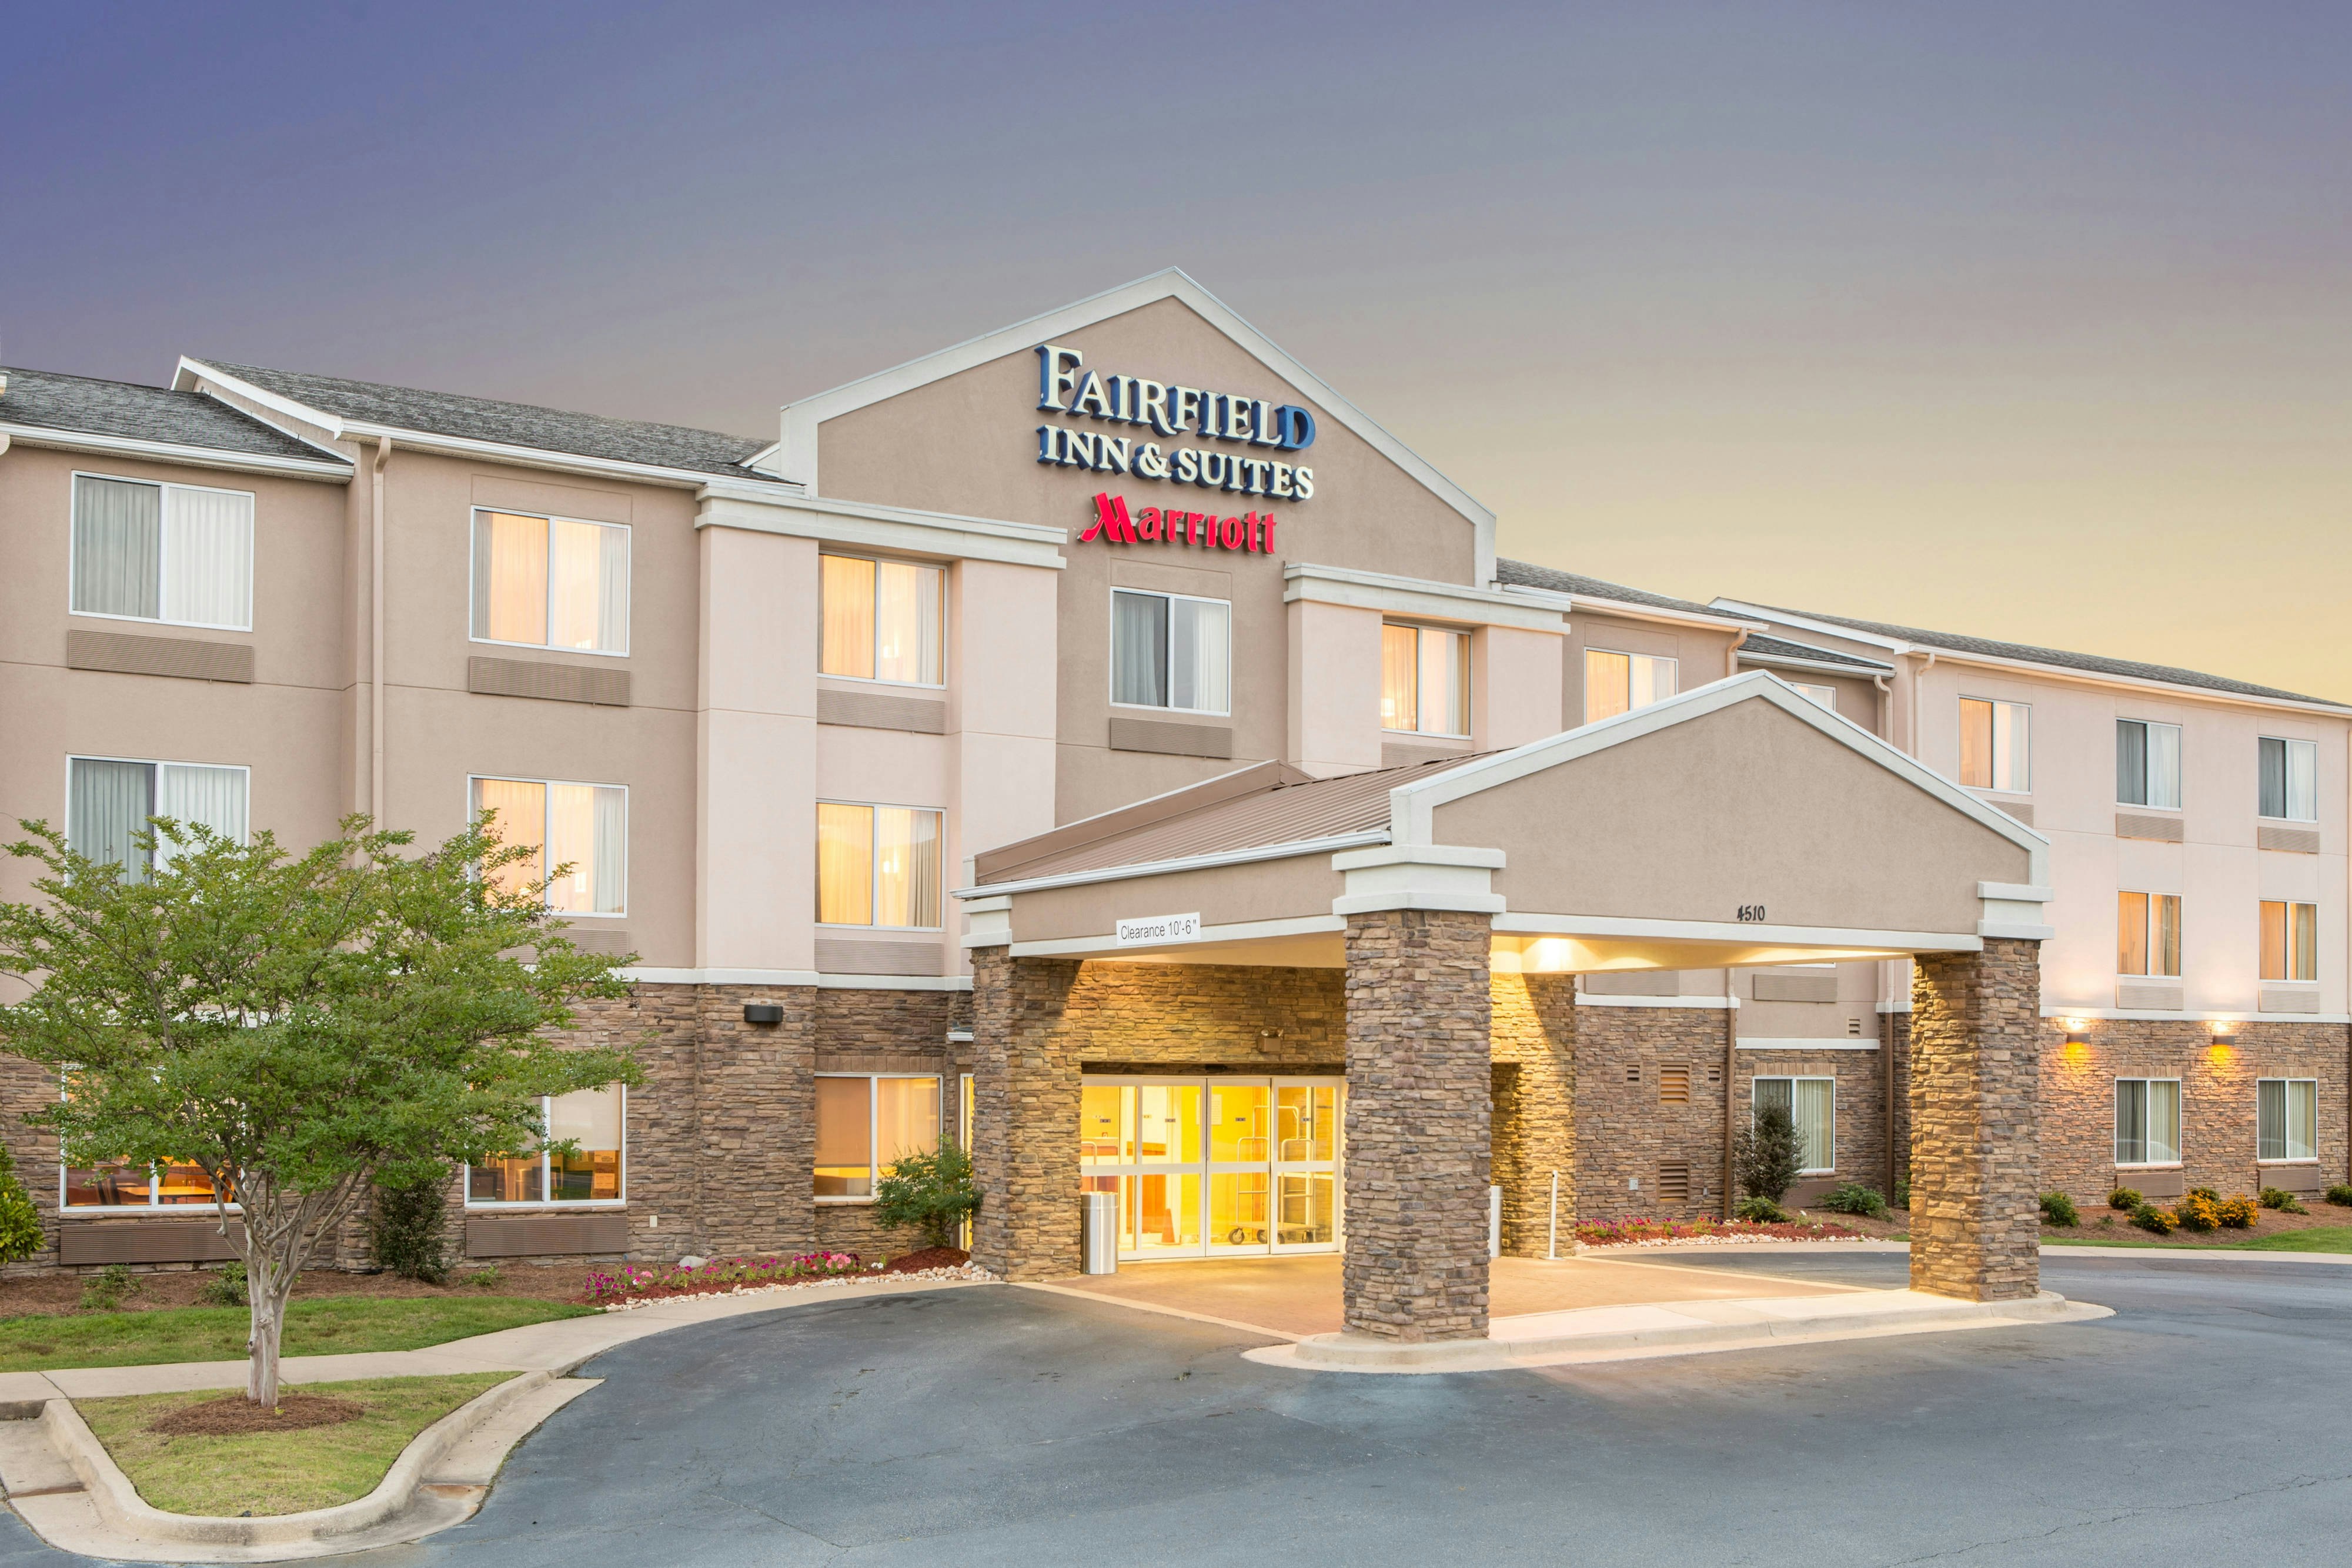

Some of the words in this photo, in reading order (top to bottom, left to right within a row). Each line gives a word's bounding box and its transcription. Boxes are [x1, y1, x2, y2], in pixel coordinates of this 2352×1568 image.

[1034, 344, 1316, 451] FAIRFIELD
[1036, 424, 1131, 474] INN
[1130, 442, 1171, 480] &
[1170, 447, 1314, 502] SUITES
[1078, 492, 1277, 554] Marriott
[1121, 925, 1165, 940] Clearance
[1736, 905, 1765, 921] 4510
